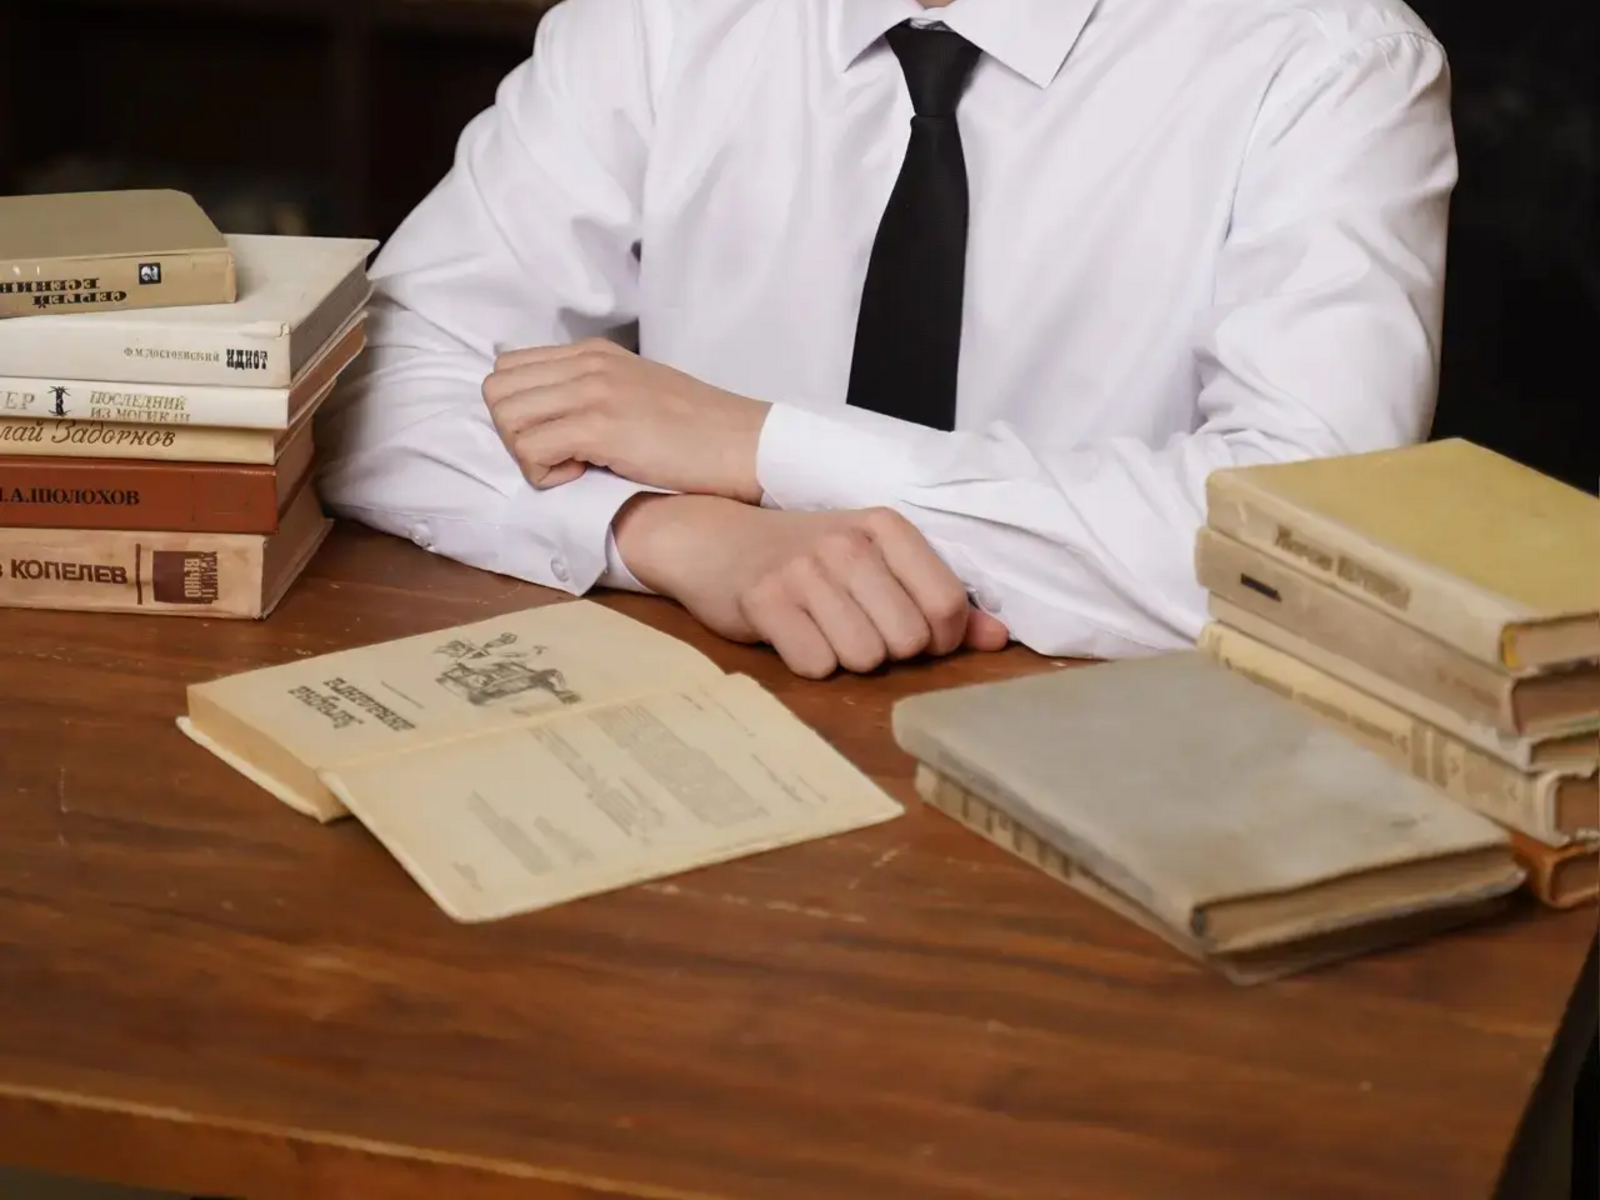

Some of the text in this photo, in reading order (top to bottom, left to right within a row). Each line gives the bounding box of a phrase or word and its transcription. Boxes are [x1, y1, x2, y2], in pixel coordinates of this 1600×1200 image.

[0, 278, 100, 294] ЕСЕНИН
[32, 291, 127, 309] СЕРГЕЙ
[226, 348, 268, 370] ИДИОТ
[0, 391, 35, 410] ЕР
[90, 391, 187, 410] ПОСЛЕДНИЙ
[90, 407, 111, 420] ИЗ
[51, 418, 176, 447] Задорнов
[0, 487, 140, 506] .А.ШОЛОХОВ
[11, 559, 128, 584] КОПЕЛЕВ
[184, 558, 201, 597] ВЕЧНО
